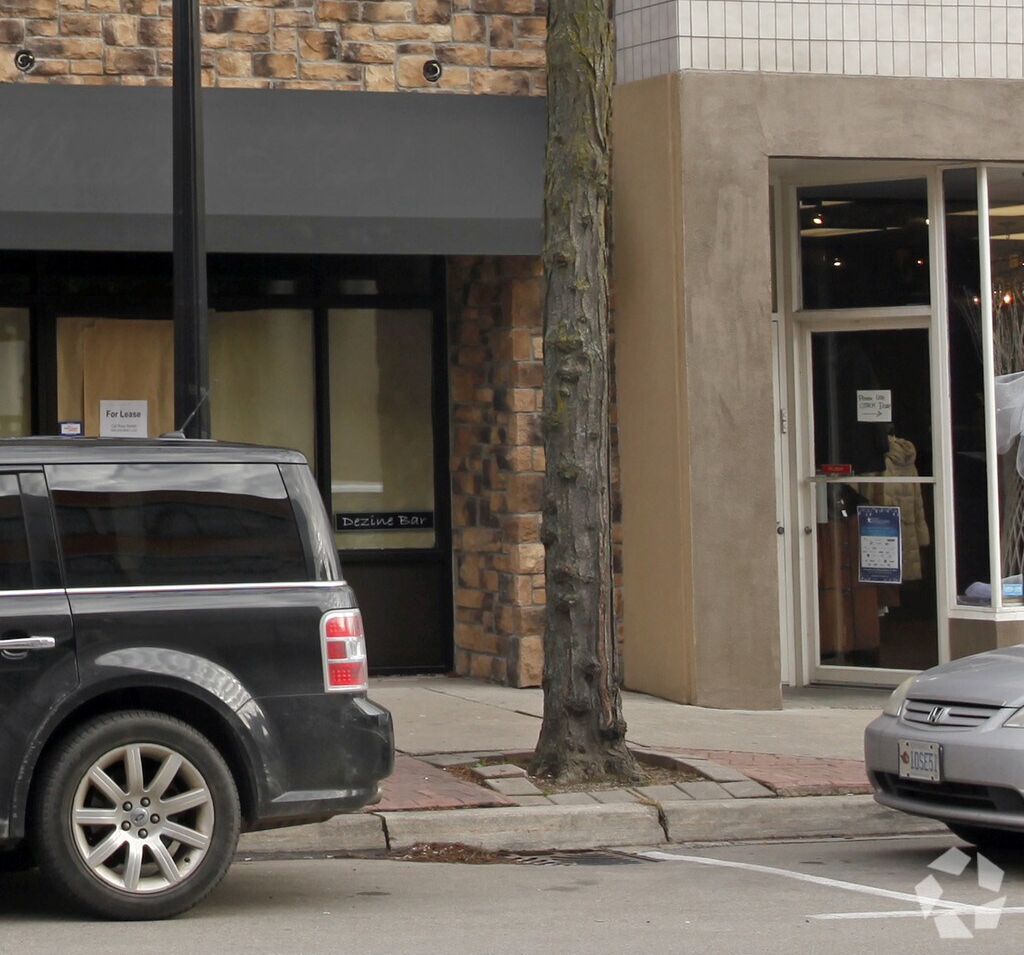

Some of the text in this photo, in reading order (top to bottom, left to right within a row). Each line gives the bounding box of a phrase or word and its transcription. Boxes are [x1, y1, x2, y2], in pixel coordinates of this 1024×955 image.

[106, 410, 141, 418] For Lease
[342, 515, 427, 527] Dezine Bar
